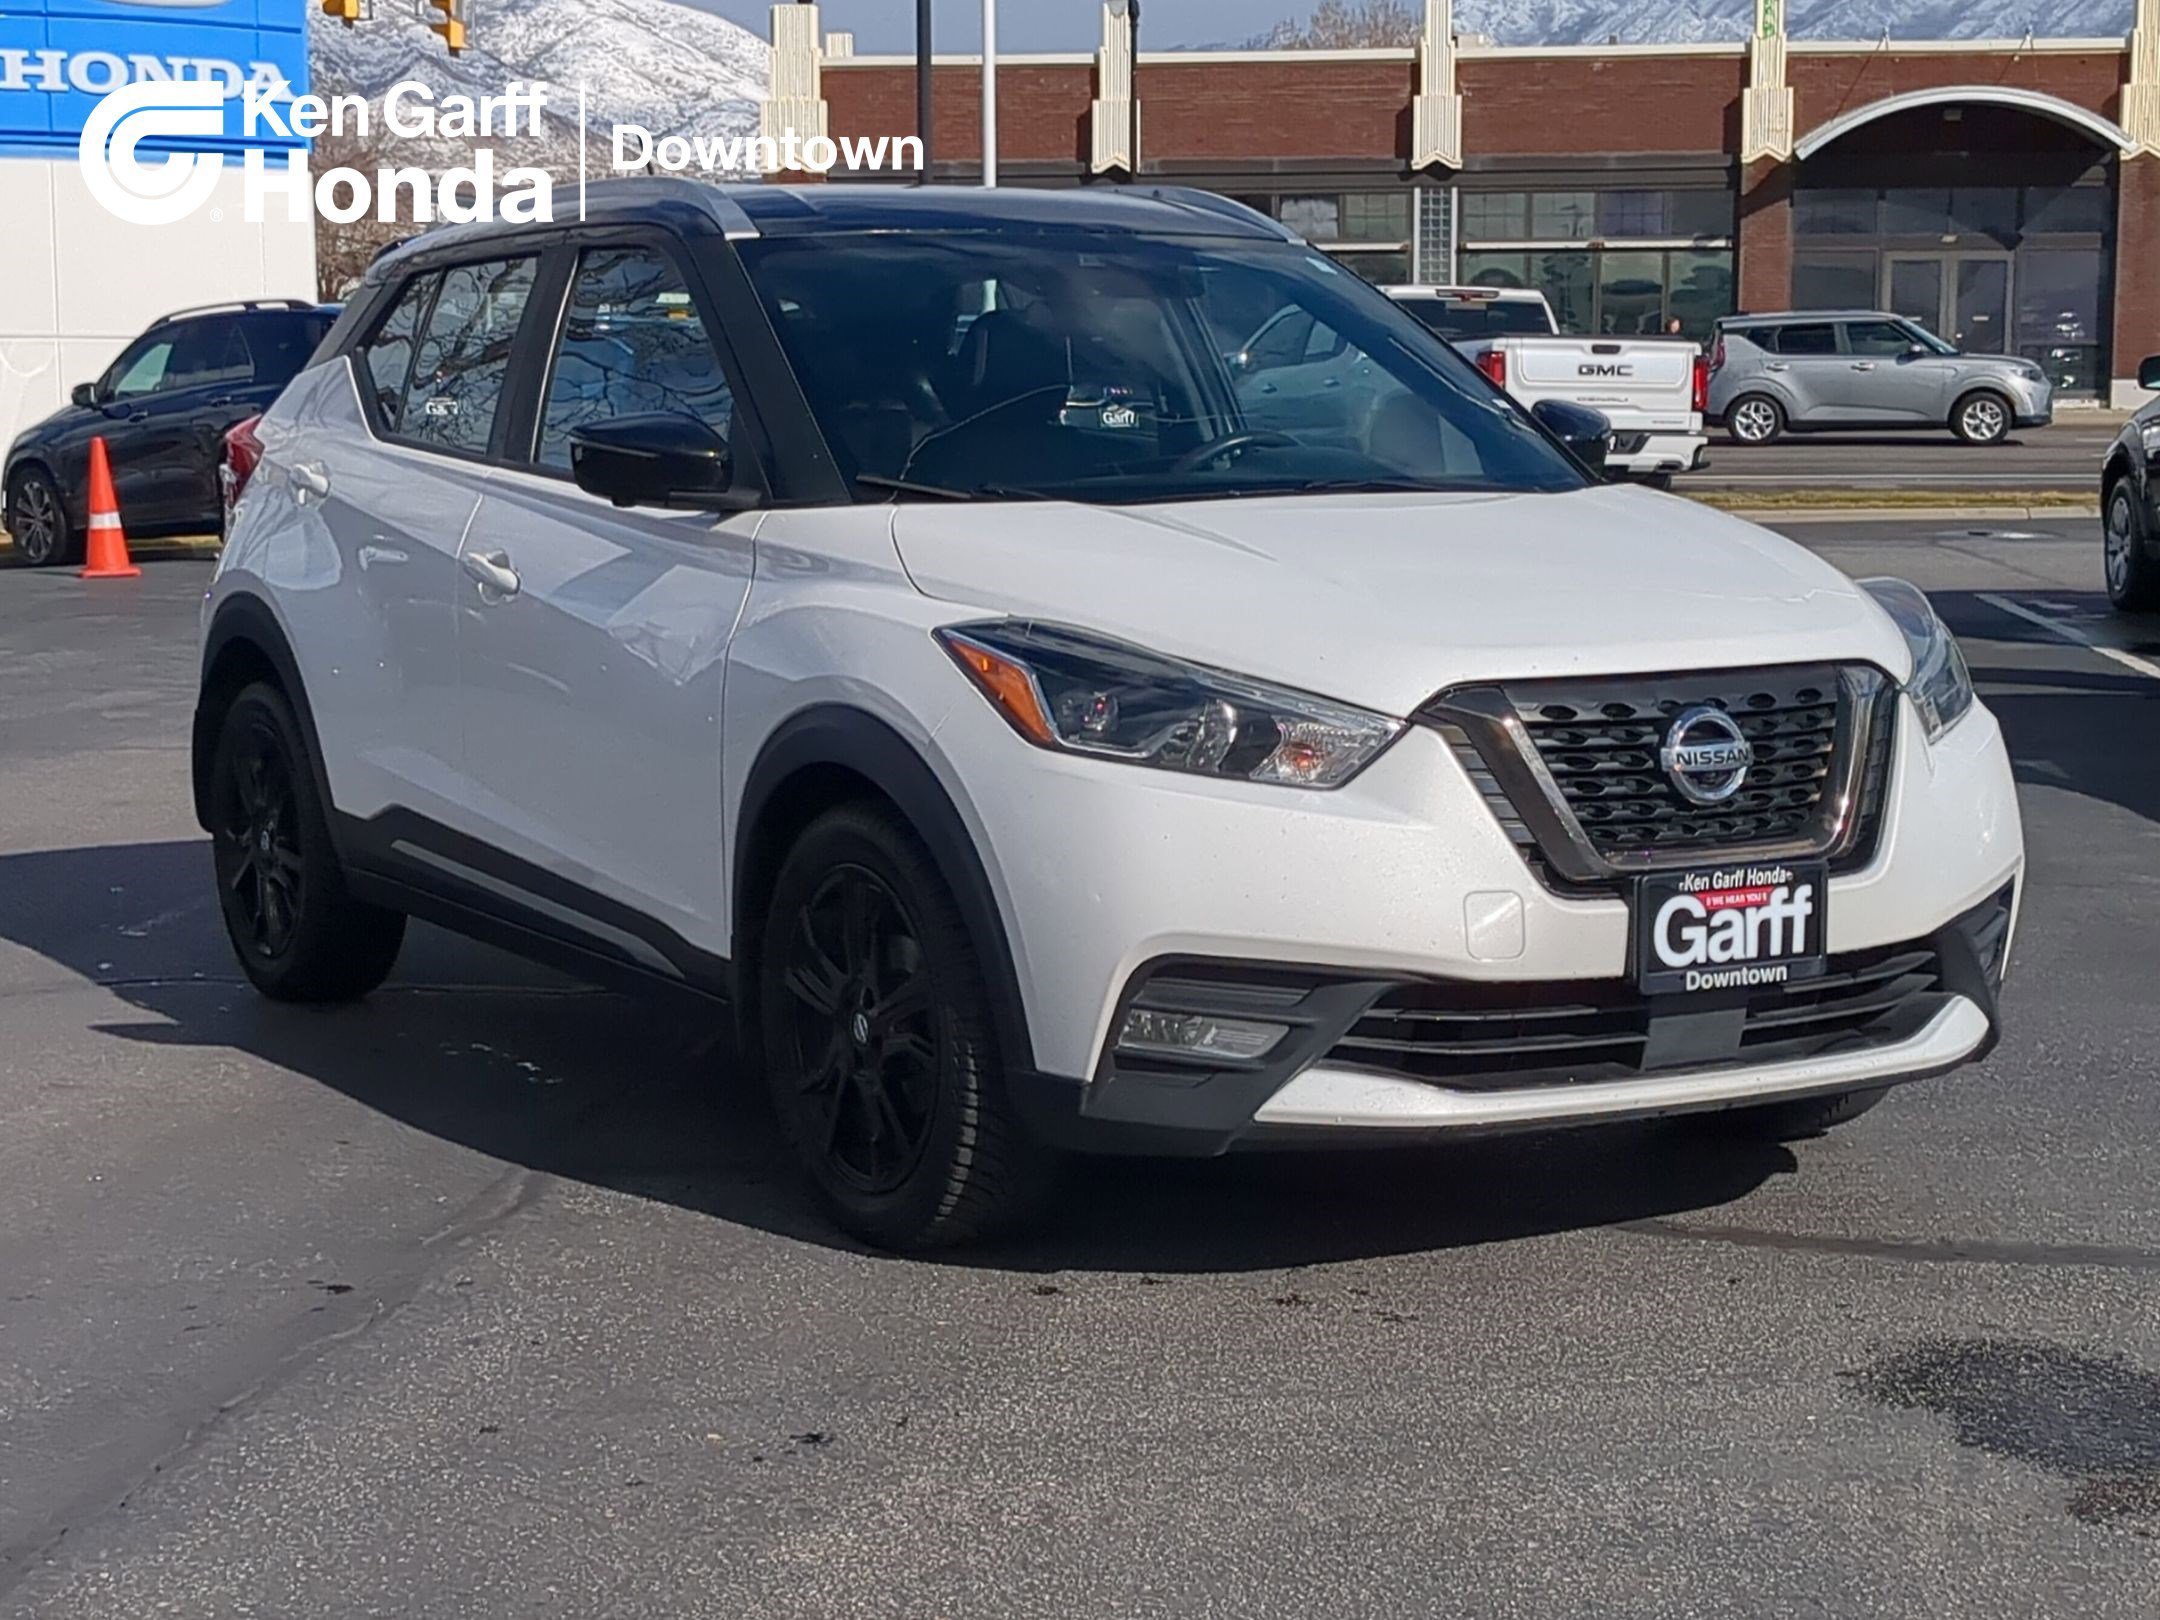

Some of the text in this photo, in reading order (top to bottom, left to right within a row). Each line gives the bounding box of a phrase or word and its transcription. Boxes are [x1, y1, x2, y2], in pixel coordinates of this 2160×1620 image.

[1578, 364, 1633, 376] GMC
[1676, 748, 1749, 766] NISSAN
[1684, 866, 1787, 892] Ken Garff Honda
[1653, 884, 1813, 968] Garff
[1685, 964, 1788, 991] Downtown
